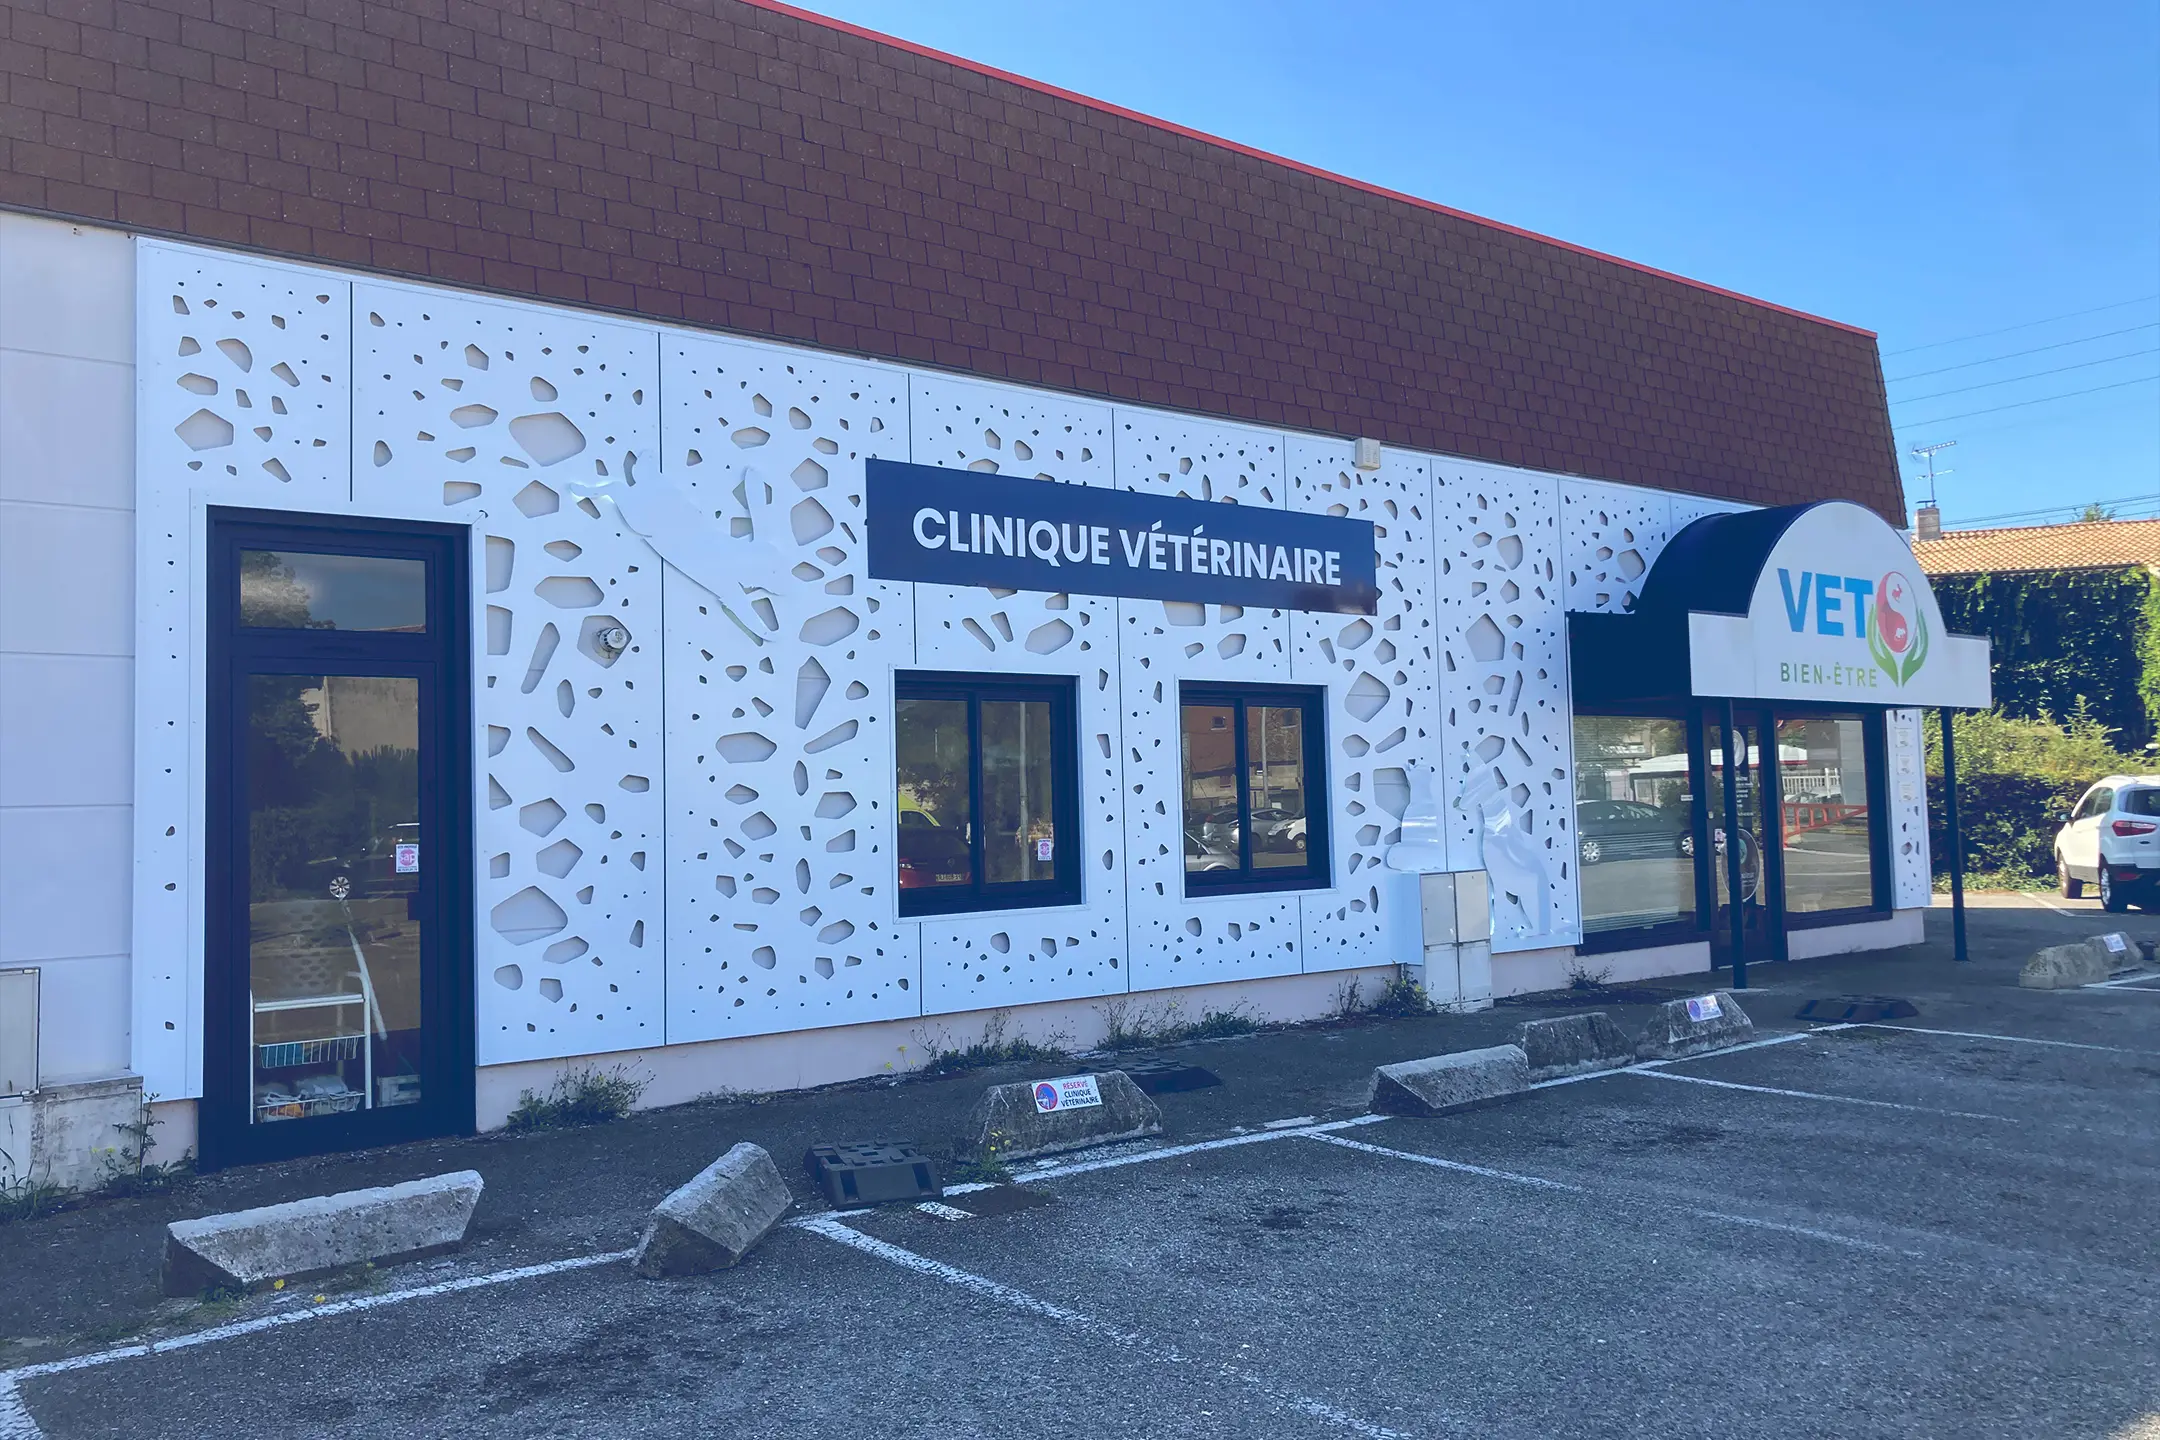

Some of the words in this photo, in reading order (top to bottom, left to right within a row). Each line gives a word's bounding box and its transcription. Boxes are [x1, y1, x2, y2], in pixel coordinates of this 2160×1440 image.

[913, 507, 1111, 567] CLINIQUE
[1118, 520, 1342, 586] VÉTÉRINAIRE
[1780, 661, 1878, 688] BIEN-ÊTRE
[1064, 1089, 1091, 1098] CLINIQUE
